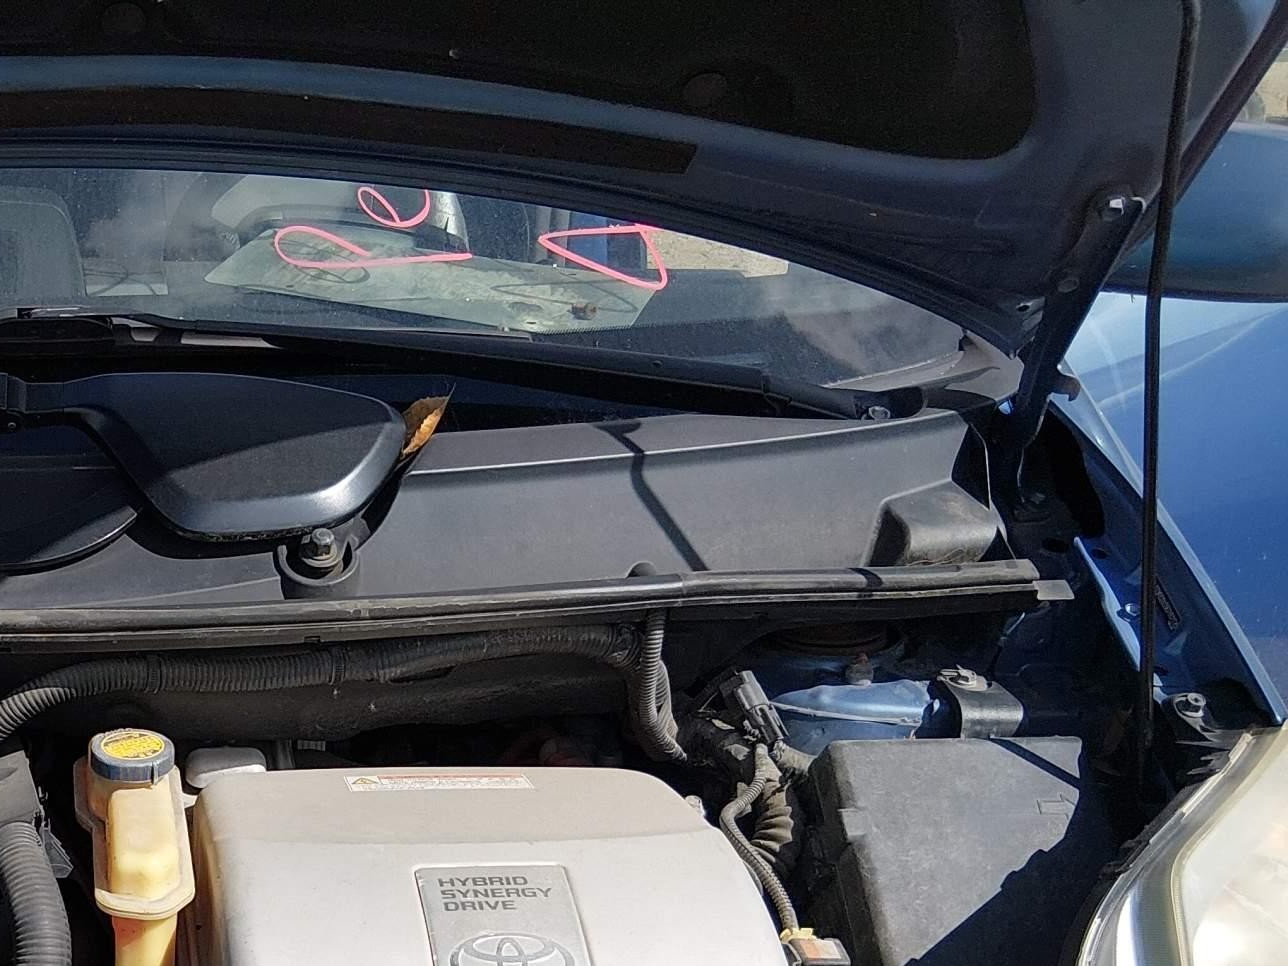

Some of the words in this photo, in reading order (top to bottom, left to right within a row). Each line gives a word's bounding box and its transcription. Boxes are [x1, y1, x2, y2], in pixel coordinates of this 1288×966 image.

[438, 876, 528, 887] HYBRID
[441, 888, 552, 900] SYNERGY
[444, 900, 517, 912] DRIVE
